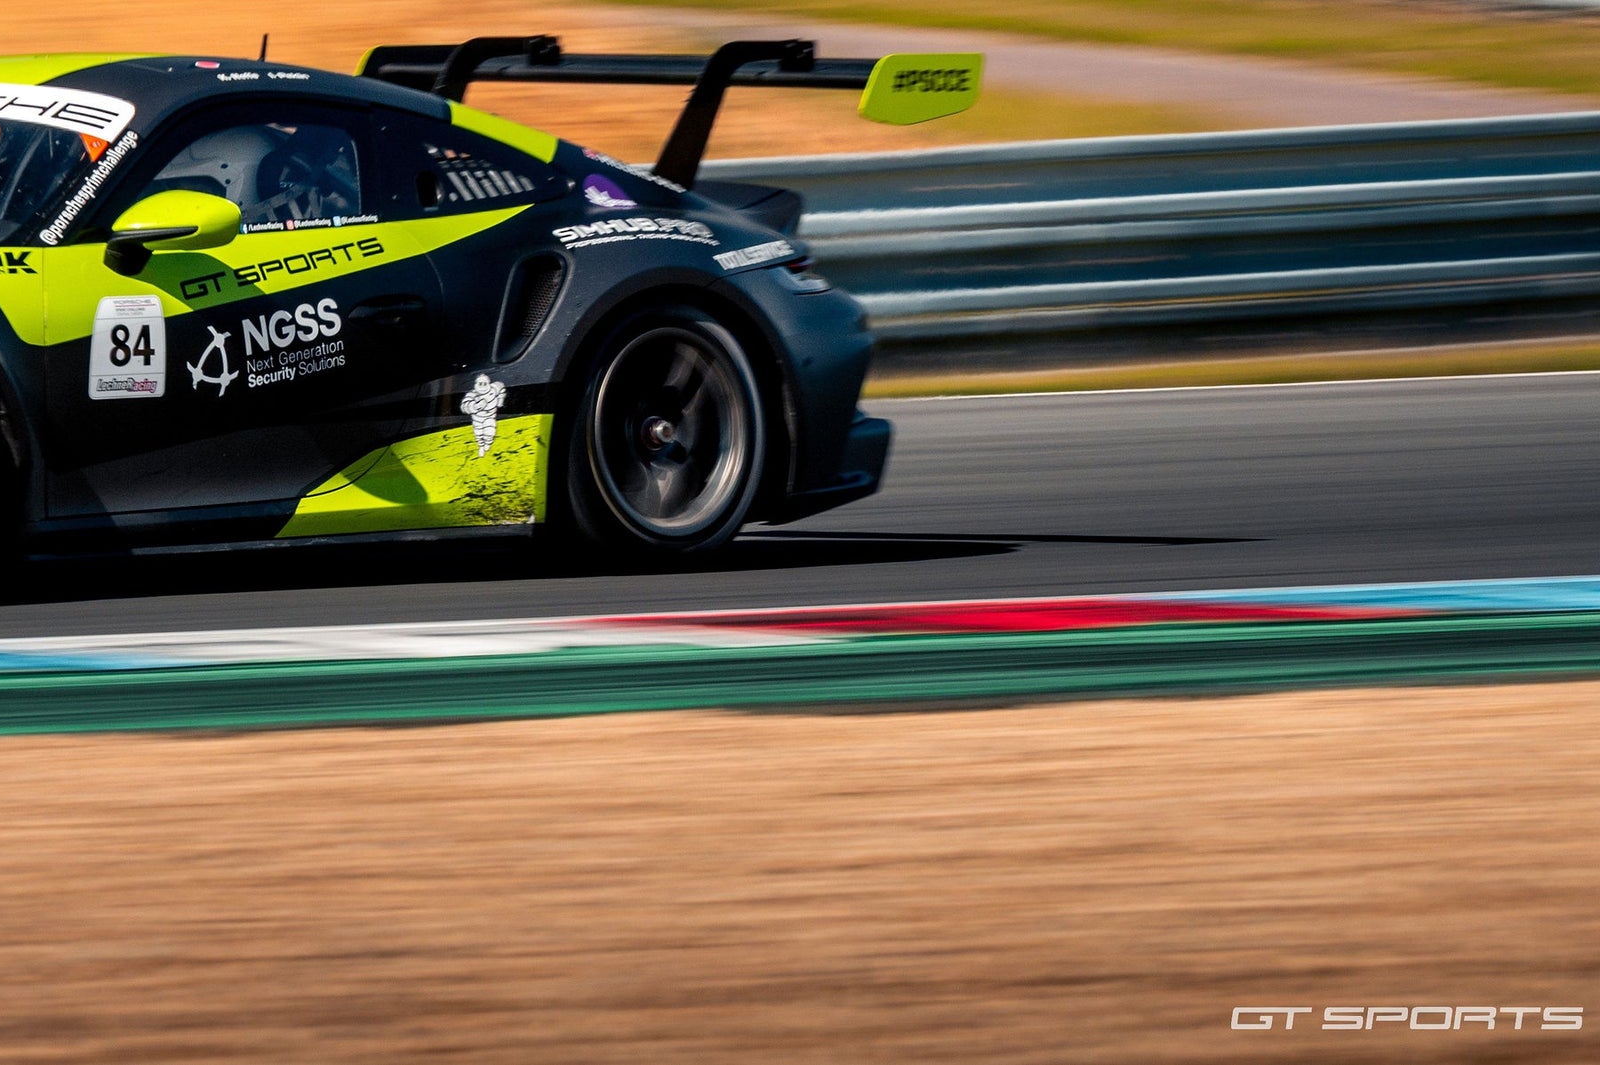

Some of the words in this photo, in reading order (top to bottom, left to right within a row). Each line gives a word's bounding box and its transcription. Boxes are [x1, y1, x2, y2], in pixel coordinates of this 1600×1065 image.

[39, 131, 138, 245] @porschesprintchallenge
[180, 272, 225, 300] GT
[234, 237, 385, 286] SPORTS
[110, 324, 155, 367] 84
[242, 298, 342, 356] NGSS
[247, 356, 275, 373] Next
[278, 340, 344, 365] Generation
[248, 366, 296, 388] Security
[299, 354, 346, 376] Solutions
